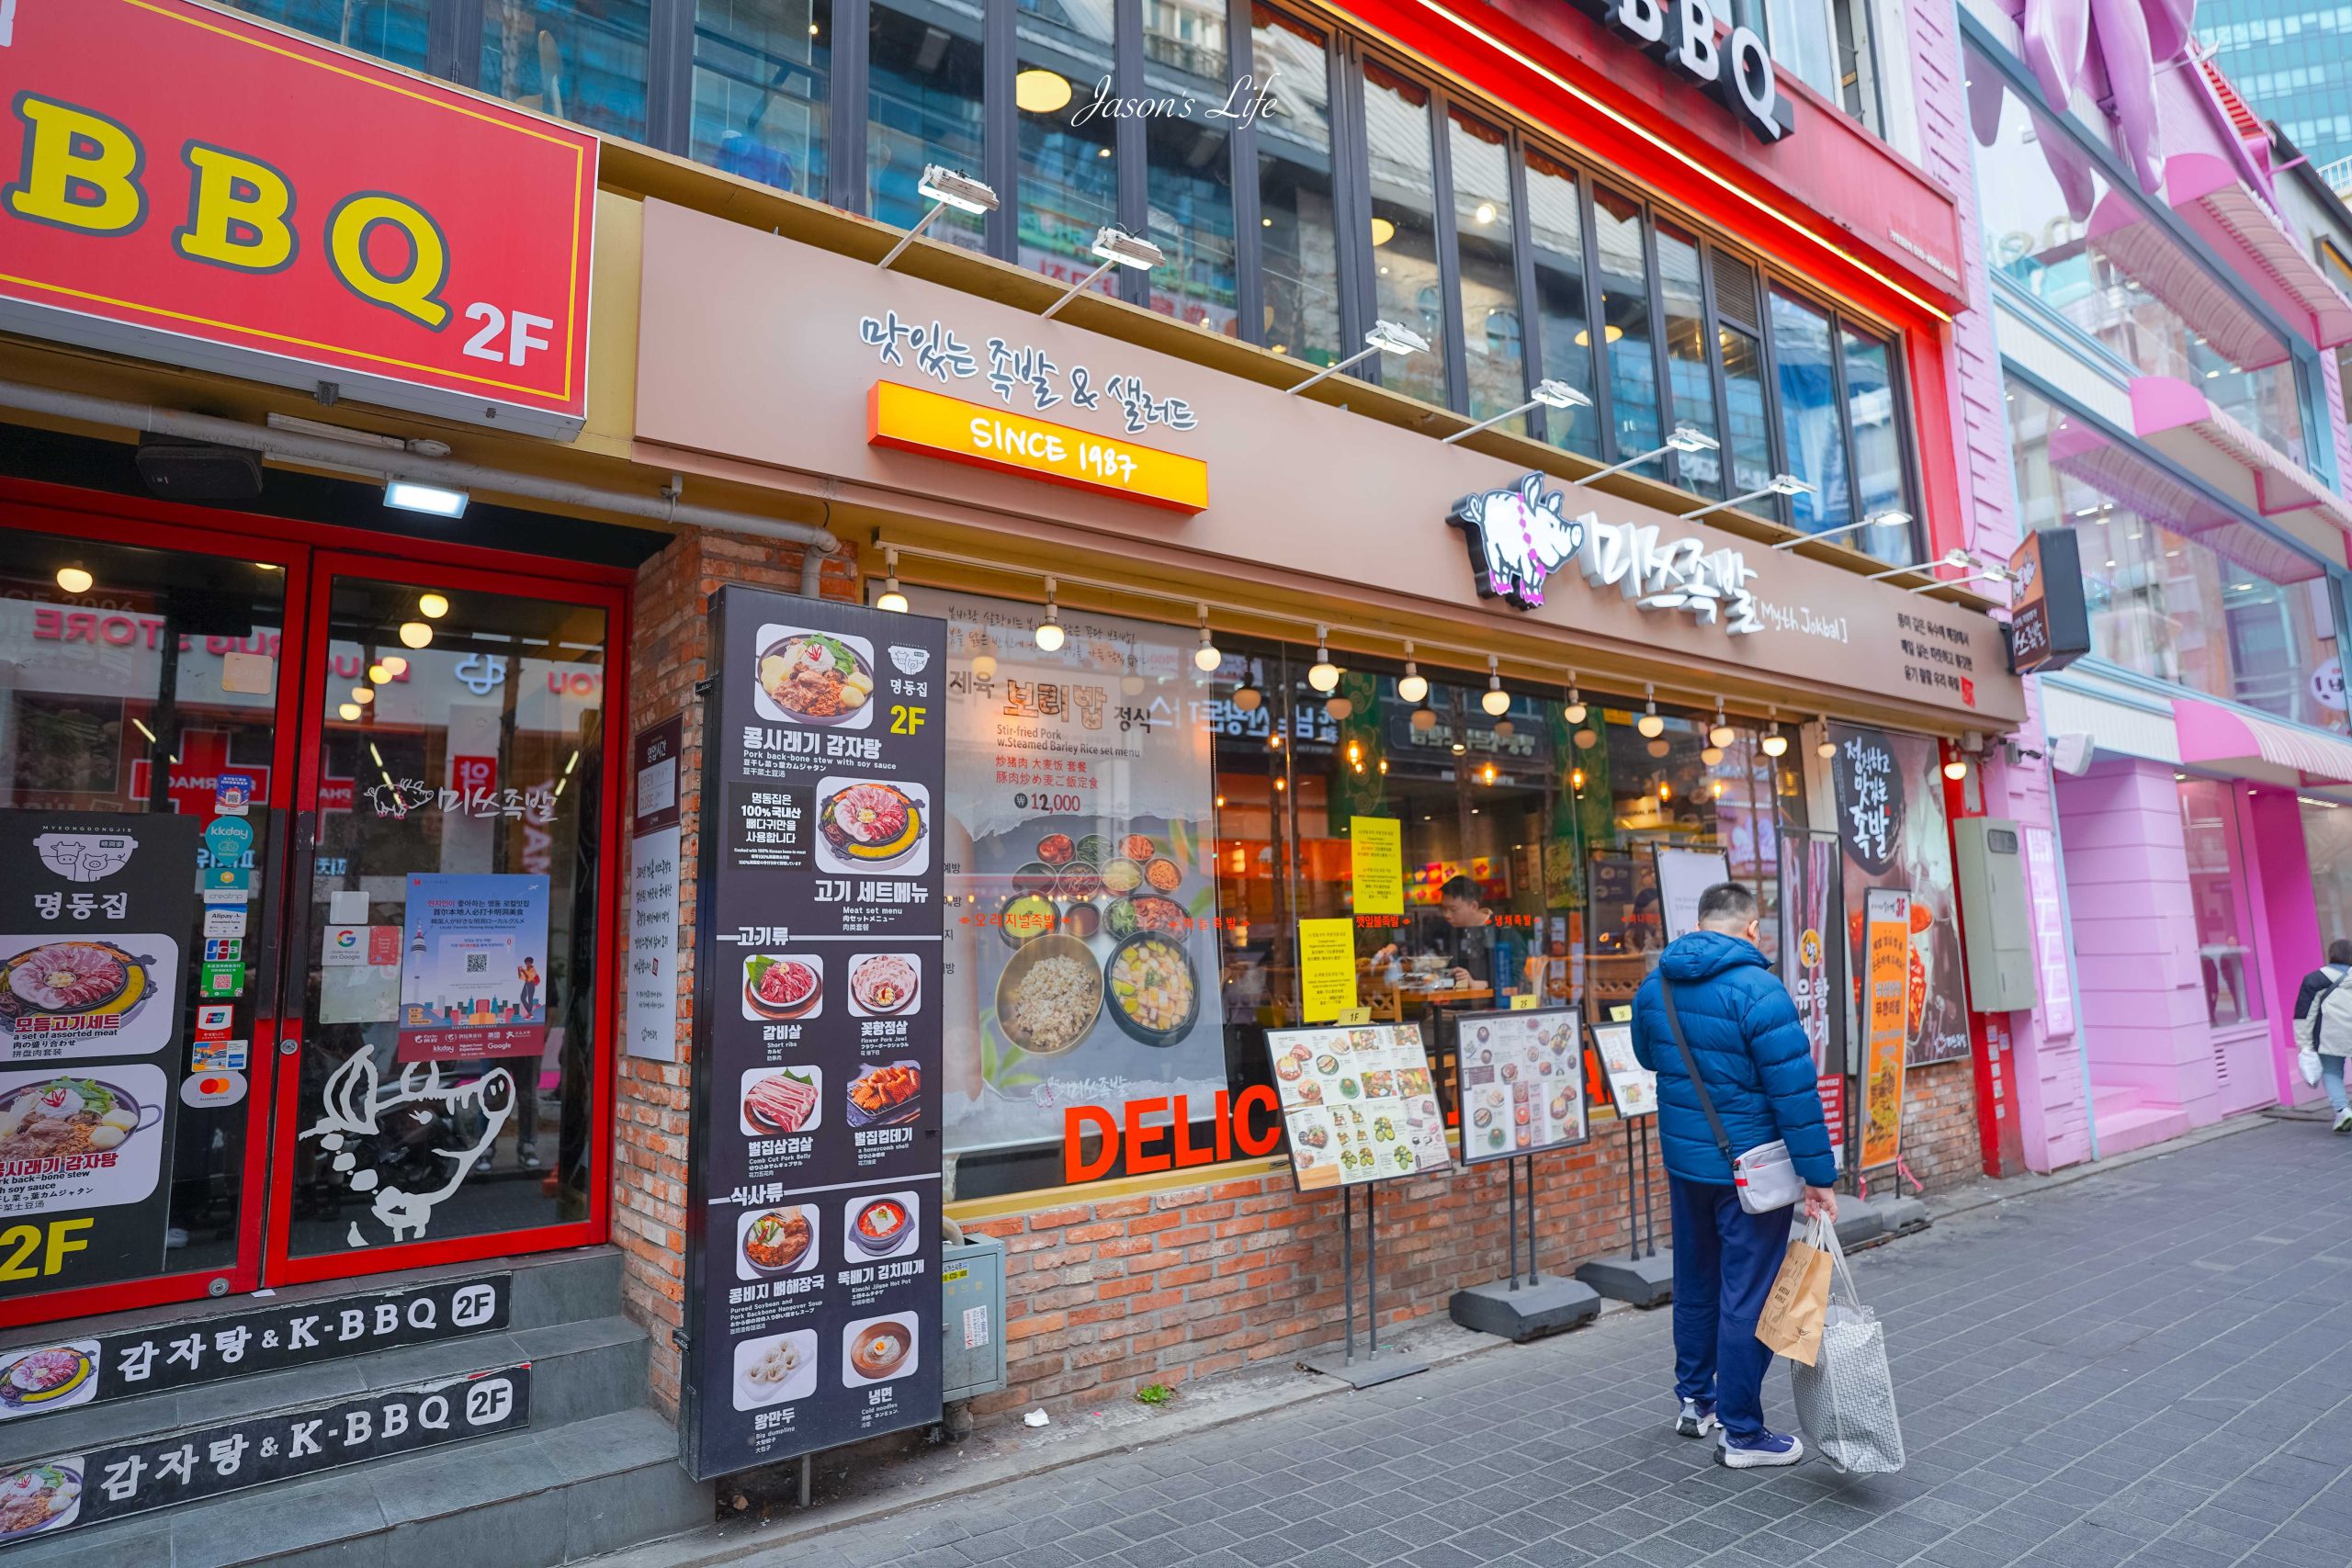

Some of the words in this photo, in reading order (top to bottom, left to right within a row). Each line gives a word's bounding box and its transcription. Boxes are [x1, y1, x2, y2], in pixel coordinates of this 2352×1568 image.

[3, 90, 453, 333] BBQ
[463, 301, 554, 367] 2F
[860, 310, 978, 383] 맛있는
[986, 338, 1063, 411] 족발
[1070, 366, 1099, 411] &
[1104, 374, 1198, 434] 샐러드
[969, 417, 1067, 462] SINCE
[1080, 442, 1137, 483] 1987
[1577, 512, 1765, 637] 미쓰족발
[889, 678, 928, 698] 명동집
[1003, 678, 1107, 730] 보리밥
[1114, 705, 1151, 734] 정식
[889, 705, 927, 735] 2F
[997, 724, 1038, 739] Stir-fried
[1041, 727, 1062, 740] Pork
[743, 726, 820, 755] 콩시래기
[827, 734, 882, 760] 감자탕
[997, 738, 1047, 751] w.Steamed
[1050, 741, 1079, 756] Barley
[1080, 745, 1099, 756] Rice
[1100, 747, 1114, 757] set
[1115, 750, 1140, 758] menu
[743, 750, 763, 759] Pork
[766, 752, 810, 762] back-bone
[857, 761, 871, 769] soy
[996, 756, 1028, 769] 炒猪肉
[1032, 758, 1064, 773] 大麦饭
[1067, 761, 1087, 773] 套餐
[1853, 769, 1888, 807] 맛있는
[437, 784, 559, 823] 미쓰족발
[752, 792, 792, 806] 명동집은
[1031, 793, 1080, 814] 12,000
[210, 826, 249, 840] kkday
[746, 831, 797, 843] 사용합니다
[1849, 801, 1890, 861] 족발
[814, 879, 851, 902] 고기
[856, 881, 929, 903] 세트메뉴
[34, 892, 128, 920] 명동집
[842, 906, 863, 914] Meat
[737, 926, 789, 946] 고기류
[15, 1014, 120, 1032] 모듬고기세트
[1350, 1011, 1359, 1022] 1F
[51, 1030, 92, 1039] assorted
[763, 1024, 802, 1041] 갈비살
[13, 1040, 76, 1049] 肉の盛り合わせ
[487, 1043, 512, 1051] Google
[748, 1136, 813, 1157] 벌집삼겹살
[854, 1127, 912, 1146] 벌집껍데기
[65, 1152, 119, 1170] 감자탕
[797, 1153, 811, 1161] Belly
[11, 1171, 64, 1184] back-bone
[67, 1170, 91, 1179] stew
[8, 1184, 26, 1194] soy
[28, 1182, 56, 1190] sauce
[730, 1182, 784, 1207] 식사류
[0, 1217, 95, 1284] 2F
[838, 1268, 874, 1285] 뚝배기
[877, 1259, 925, 1279] 김치찌개
[729, 1286, 769, 1304] 콩비지
[774, 1274, 825, 1298] 뼈해장국
[730, 1305, 752, 1314] Pureed
[754, 1302, 779, 1311] Soybean
[730, 1313, 744, 1321] Pork
[747, 1308, 776, 1318] Backbone
[778, 1303, 804, 1314] Hangover
[805, 1300, 823, 1309] Soup
[116, 1325, 251, 1383] 감자탕
[260, 1328, 279, 1348] &
[287, 1295, 437, 1351] K-BBQ
[456, 1291, 494, 1325] 2F
[868, 1386, 893, 1405] 냉면
[876, 1403, 898, 1412] noodles
[754, 1406, 796, 1430] 왕만두
[100, 1434, 248, 1502] 감자탕
[259, 1436, 279, 1458] &
[288, 1393, 450, 1460] K-BBQ
[471, 1384, 509, 1421] 2F
[755, 1432, 766, 1440] Big
[768, 1426, 796, 1437] dumpling
